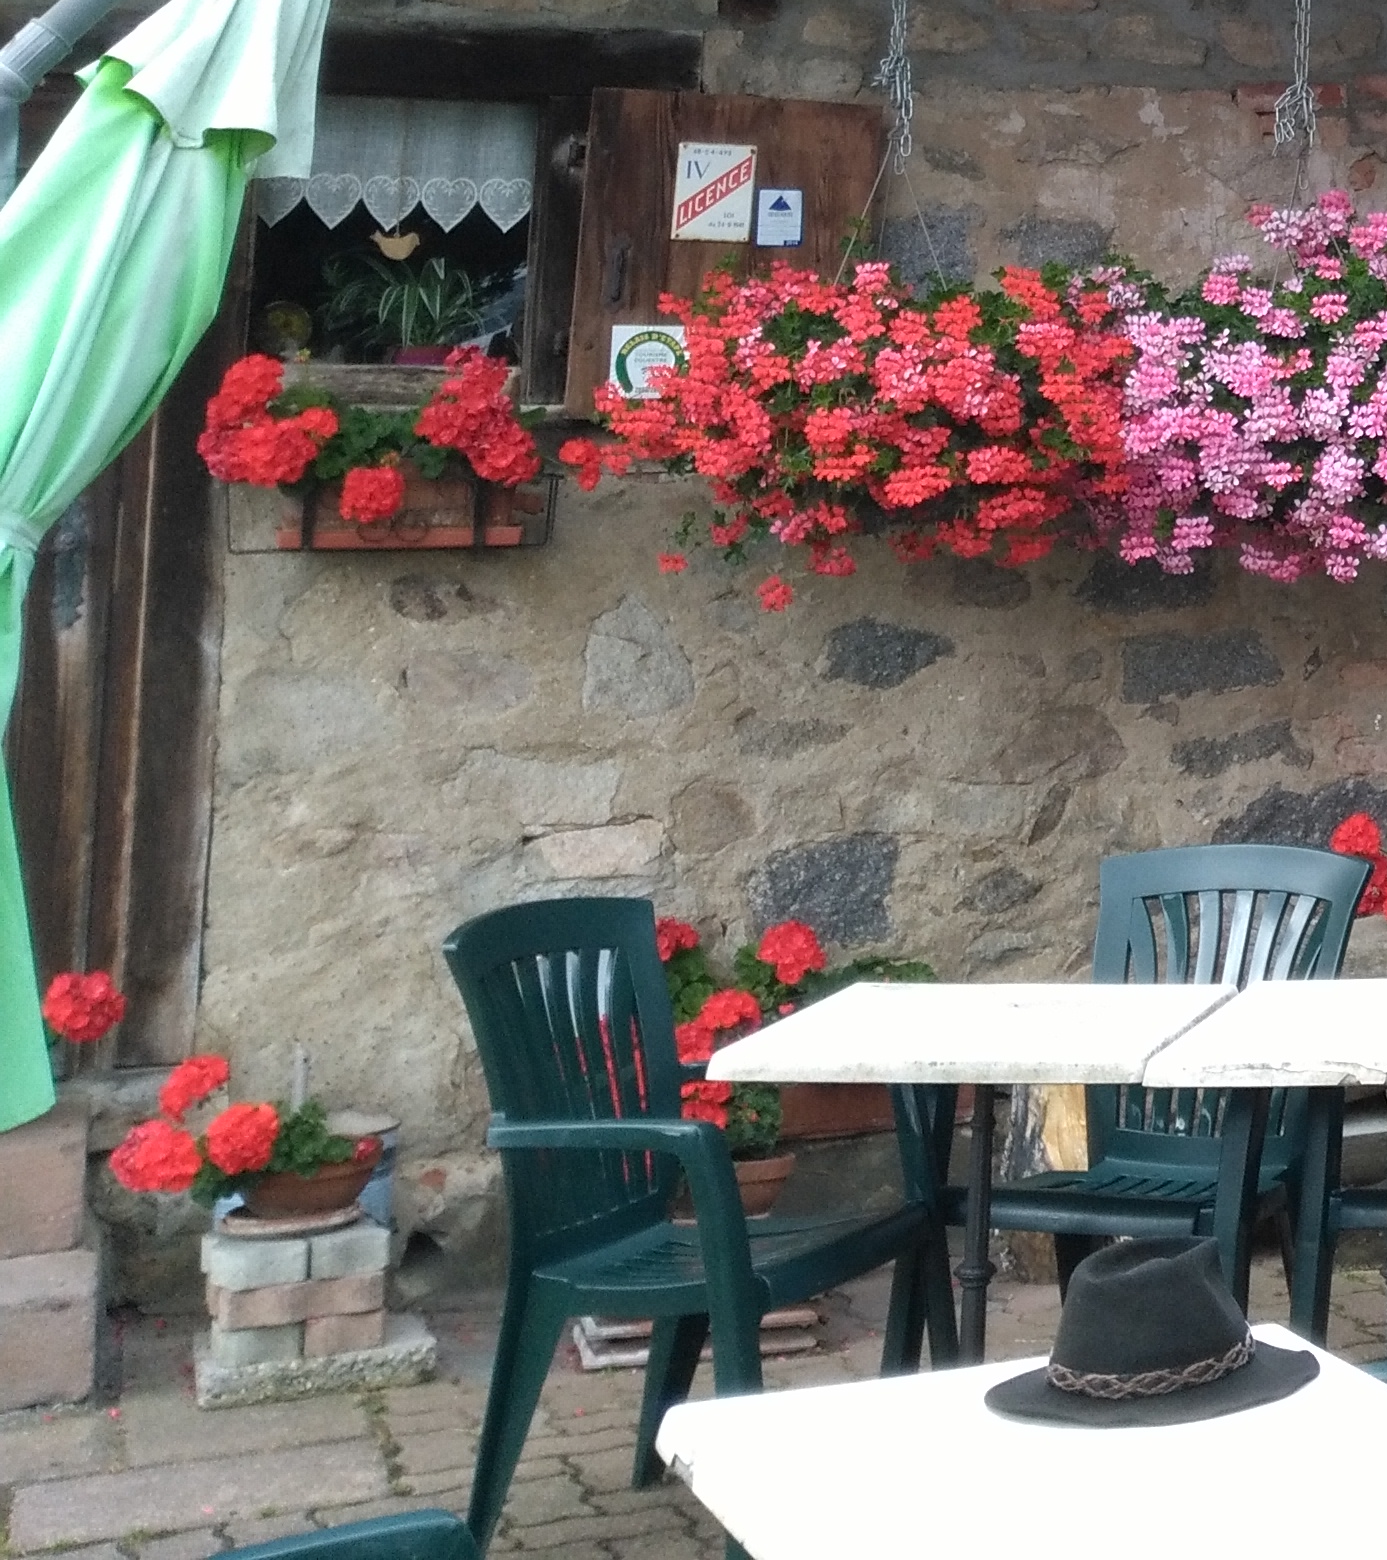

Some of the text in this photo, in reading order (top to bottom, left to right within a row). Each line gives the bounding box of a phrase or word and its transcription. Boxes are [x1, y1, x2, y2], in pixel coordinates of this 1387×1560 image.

[687, 160, 711, 179] IV
[679, 161, 749, 224] LICENCE
[621, 333, 650, 355] RELAIS
